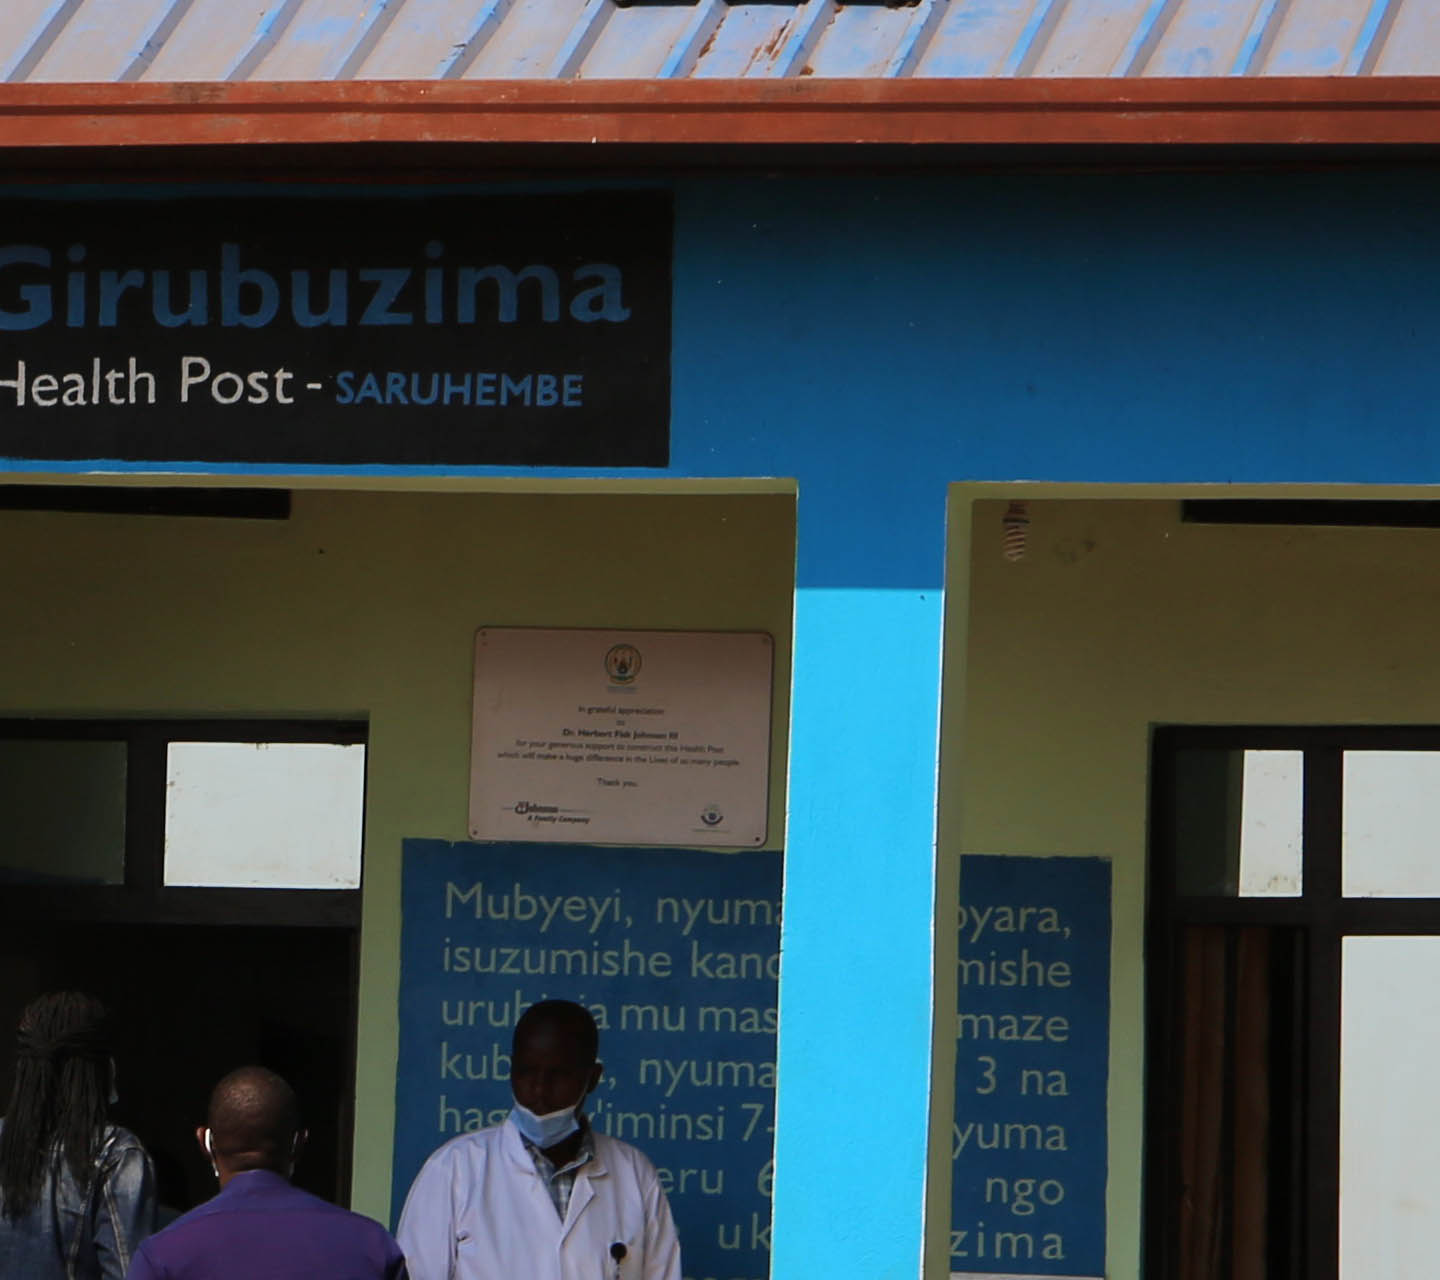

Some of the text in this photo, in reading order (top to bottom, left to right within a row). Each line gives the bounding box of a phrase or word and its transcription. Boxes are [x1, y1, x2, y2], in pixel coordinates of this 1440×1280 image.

[181, 357, 294, 404] Post
[336, 371, 583, 406] SARUHEMBE
[446, 882, 632, 934] Mubyeyi,
[444, 937, 672, 977] isuzumishe
[621, 1005, 685, 1031] mu
[976, 1056, 1068, 1096] 3 na
[986, 1178, 1064, 1216] ngo
